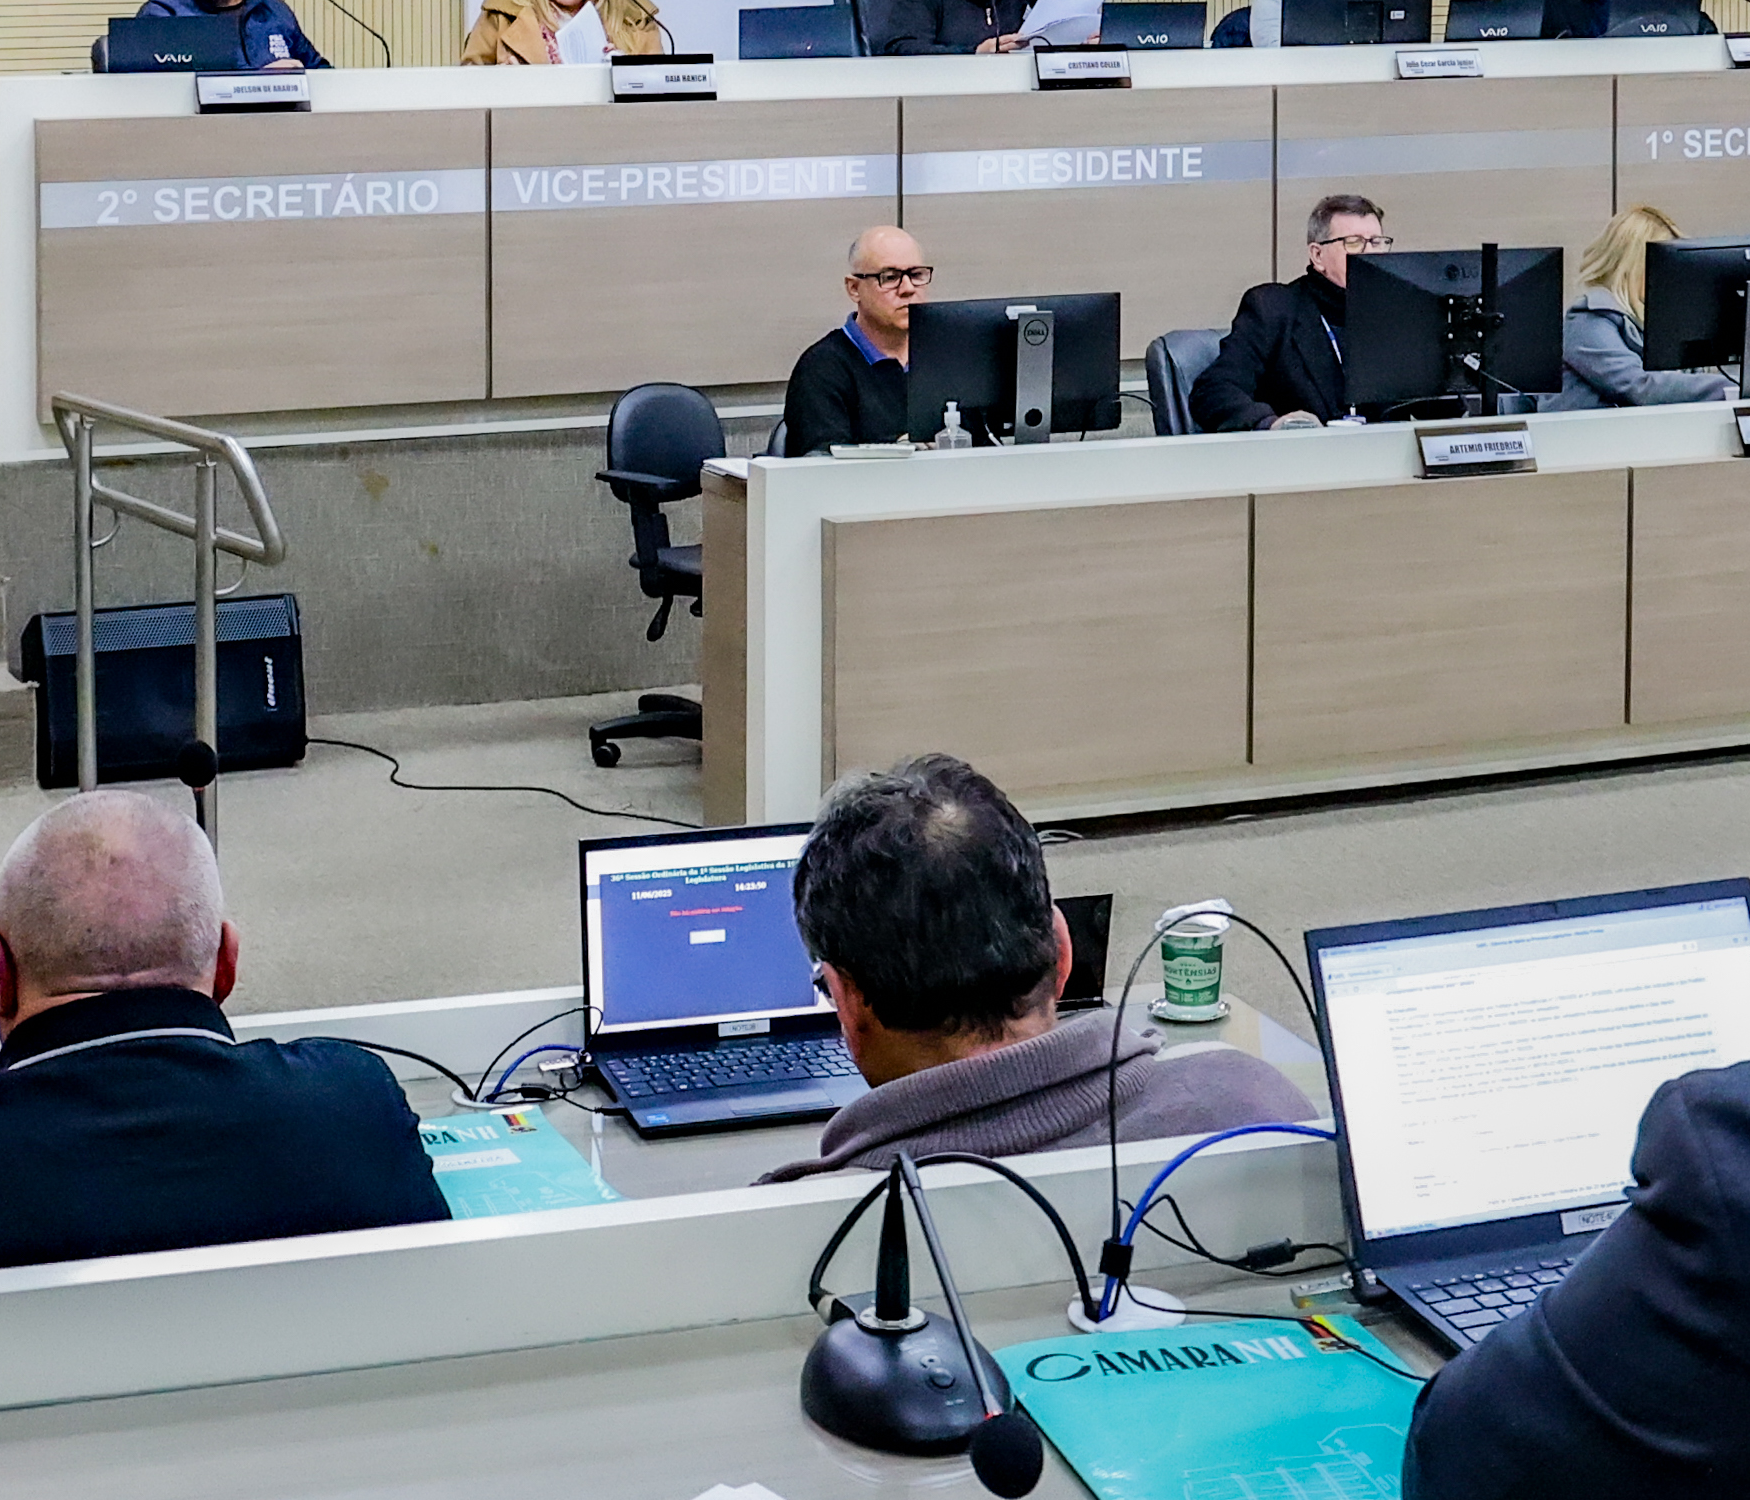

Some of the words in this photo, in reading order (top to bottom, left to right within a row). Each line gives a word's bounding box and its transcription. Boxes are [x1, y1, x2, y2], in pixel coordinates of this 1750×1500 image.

[1479, 27, 1509, 38] VAIO
[1640, 23, 1668, 33] VAIO
[1137, 34, 1168, 45] VAIO
[1068, 61, 1100, 70] CRISTIANO
[233, 85, 262, 94] JOELSON
[976, 145, 1204, 186] PRESIDENTE
[512, 156, 868, 206] VICE-PRESIDENTE
[152, 172, 441, 224] SECRETÁRIO
[1484, 440, 1523, 452] FRIEDRICH
[625, 872, 651, 882] Sessão
[652, 869, 687, 879] Ordinária
[688, 868, 699, 876] da
[709, 864, 735, 874] Sessão
[735, 861, 775, 874] Legislativa
[776, 861, 786, 869] da
[685, 874, 727, 885] Legislatura
